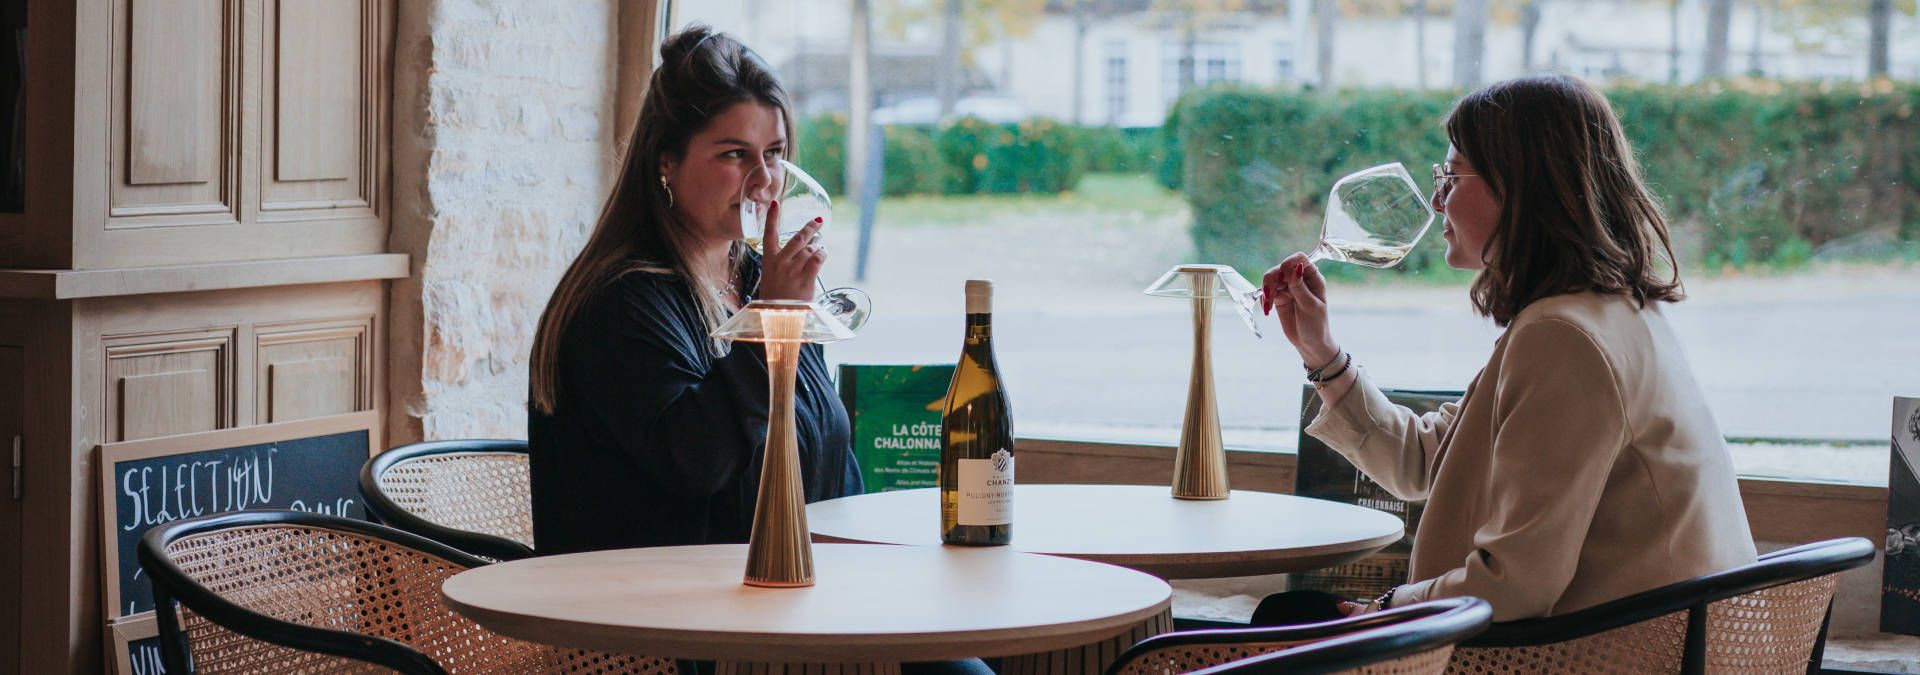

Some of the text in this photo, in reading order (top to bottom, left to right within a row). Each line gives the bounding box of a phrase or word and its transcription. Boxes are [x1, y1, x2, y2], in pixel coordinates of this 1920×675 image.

[893, 421, 941, 436] LA CÔTE
[123, 448, 277, 531] SELECTION
